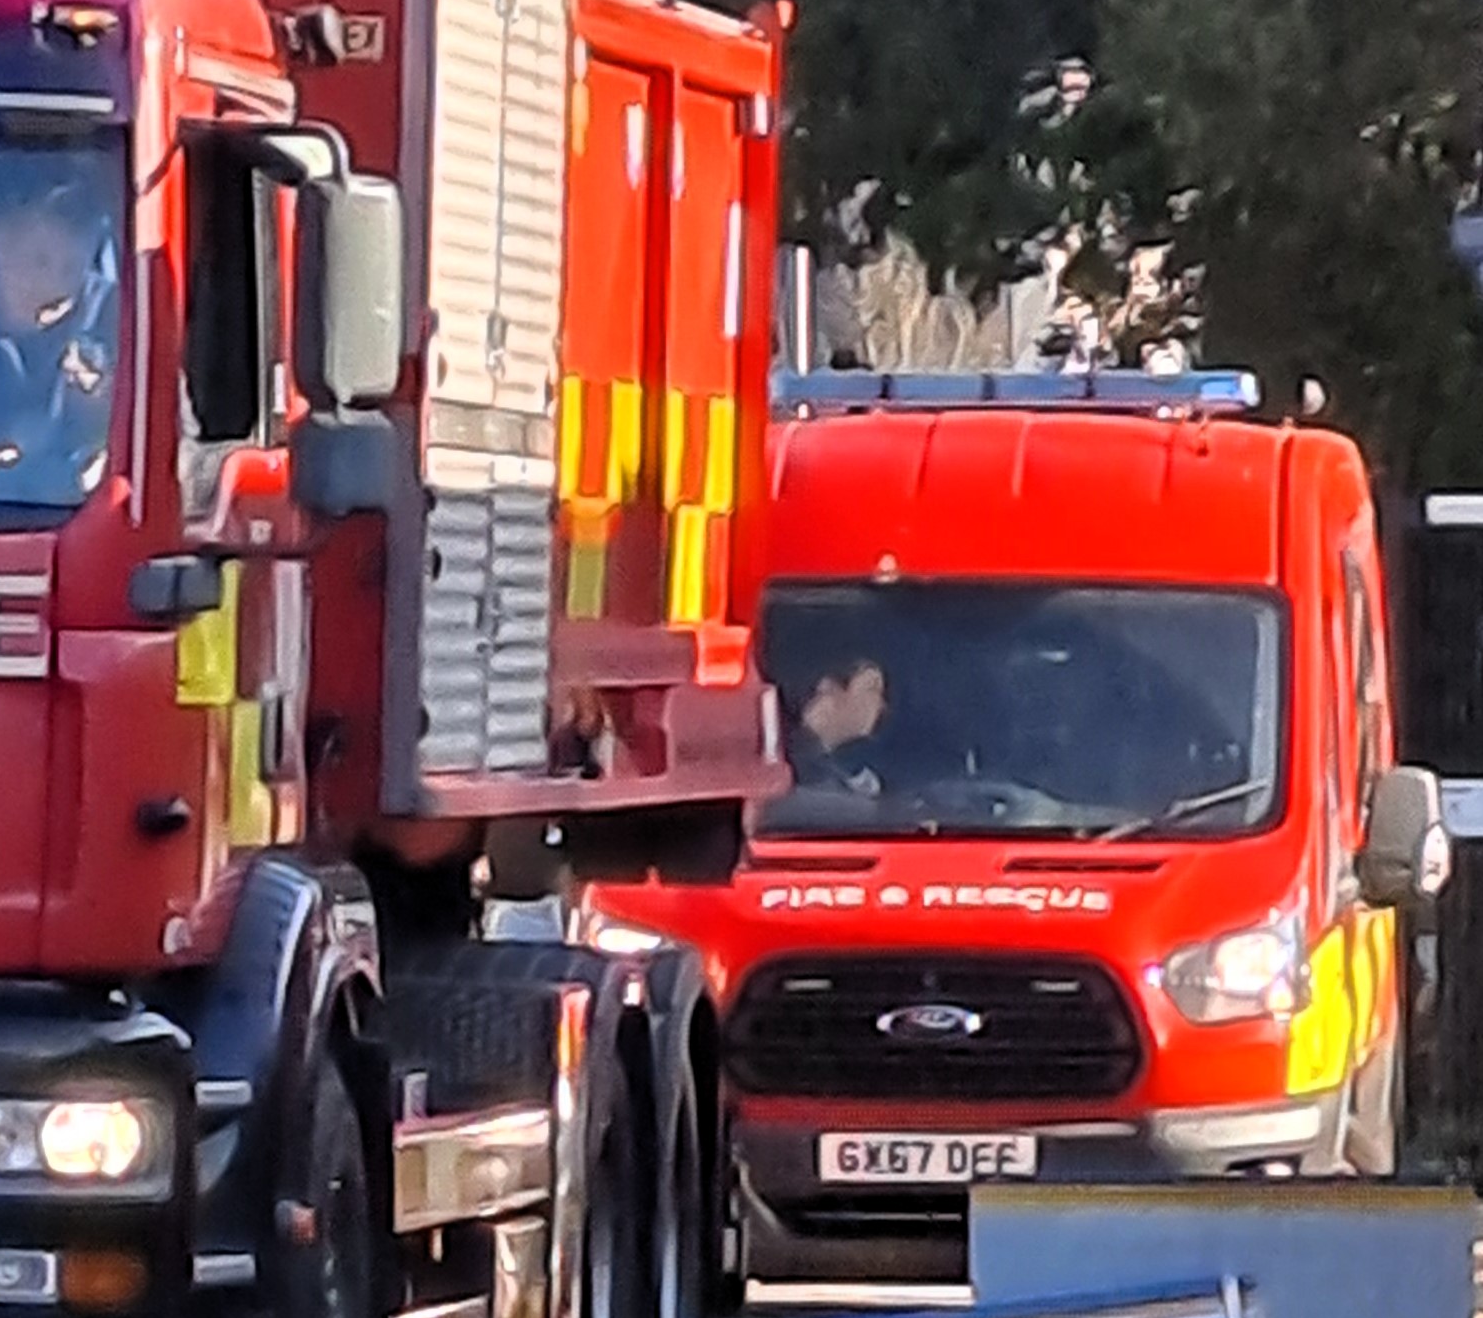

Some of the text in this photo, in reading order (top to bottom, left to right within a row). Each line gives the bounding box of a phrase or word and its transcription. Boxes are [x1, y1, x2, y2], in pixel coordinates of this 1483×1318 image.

[761, 885, 866, 909] FIRE
[922, 885, 1110, 911] RESCUE
[837, 1141, 935, 1174] GX67
